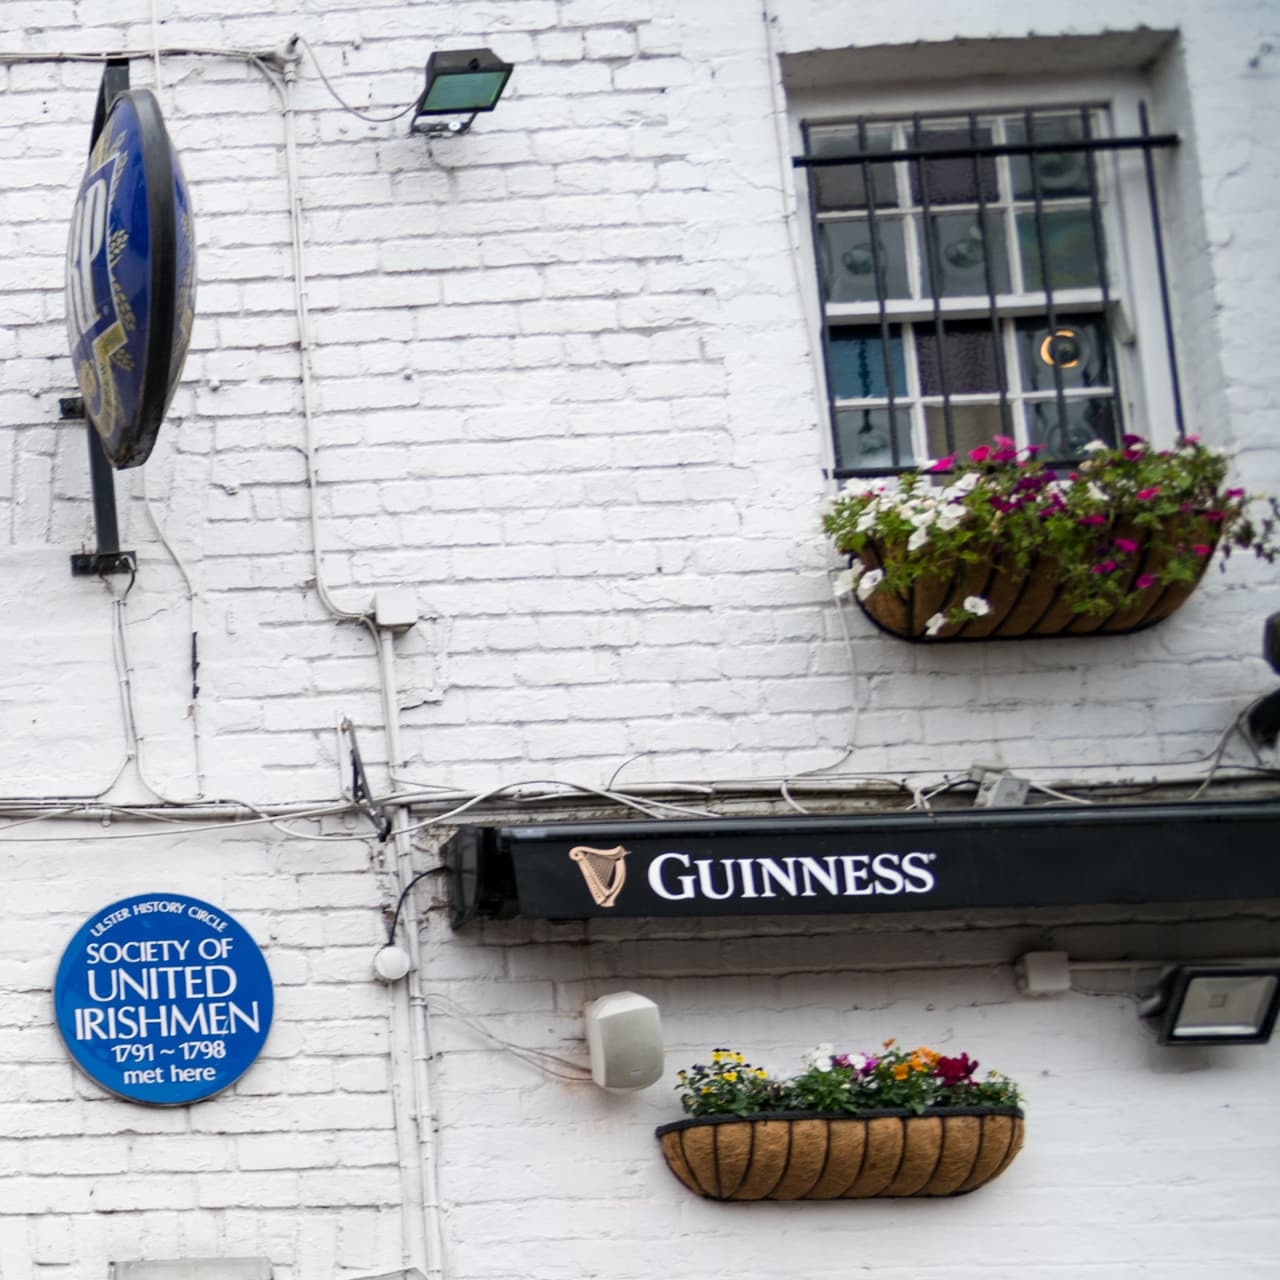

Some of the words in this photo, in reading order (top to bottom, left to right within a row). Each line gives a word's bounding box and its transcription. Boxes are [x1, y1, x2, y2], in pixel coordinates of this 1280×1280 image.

[647, 852, 936, 900] GUINNESS
[90, 909, 132, 938] ULSTER
[133, 902, 186, 915] HISTORY
[188, 906, 228, 933] CIRCLE
[86, 940, 190, 964] SOCIETY
[198, 938, 233, 960] OF
[87, 965, 237, 1002] UNITED
[74, 1001, 261, 1041] IRISHMEN
[111, 1043, 154, 1063] 1791
[179, 1040, 227, 1060] 1798
[123, 1066, 164, 1085] met
[170, 1065, 216, 1083] here
